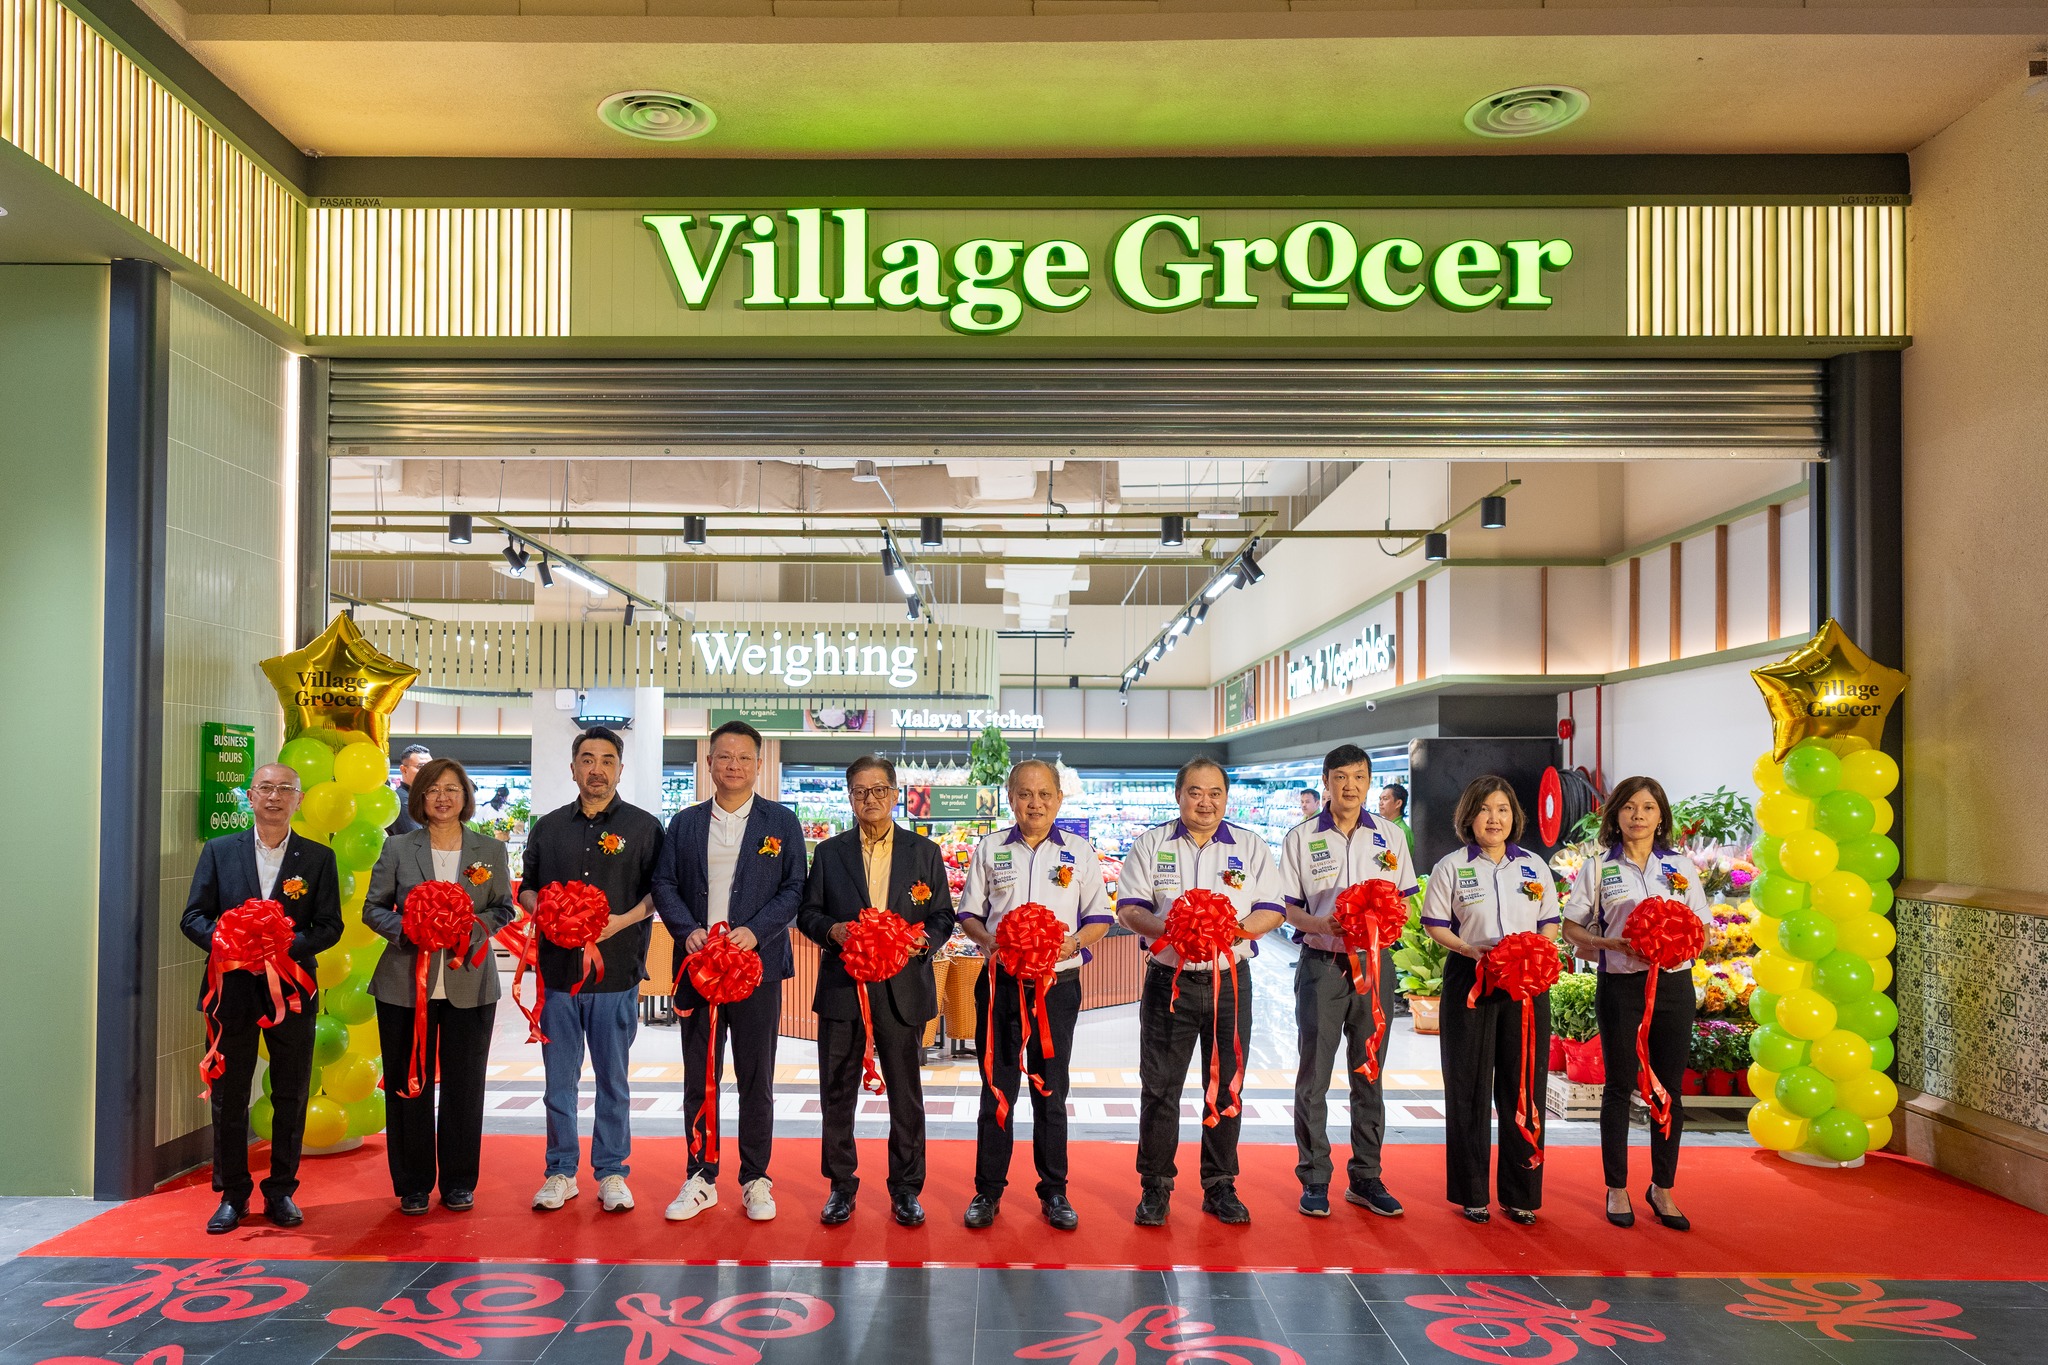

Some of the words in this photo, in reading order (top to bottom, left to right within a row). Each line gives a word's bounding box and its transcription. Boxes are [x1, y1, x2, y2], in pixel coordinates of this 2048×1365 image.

[320, 198, 353, 207] PASAR
[355, 198, 381, 207] RAYA
[643, 207, 1091, 334] Village
[1112, 213, 1574, 313] Grocer
[691, 631, 919, 688] Weighing
[1287, 655, 1313, 700] Fruits
[1314, 648, 1325, 693] &
[1325, 624, 1394, 695] Vegetables
[296, 671, 369, 692] Village
[295, 690, 369, 707] Grocer
[1806, 680, 1880, 701] Village
[750, 709, 778, 718] organic.
[1806, 701, 1881, 717] Grocer
[891, 708, 963, 732] Malaya
[967, 709, 1045, 729] Kitchen
[213, 735, 248, 747] BUSINESS
[219, 752, 243, 763] HOURS
[216, 771, 245, 783] 10.00am
[215, 792, 244, 806] 10.00p
